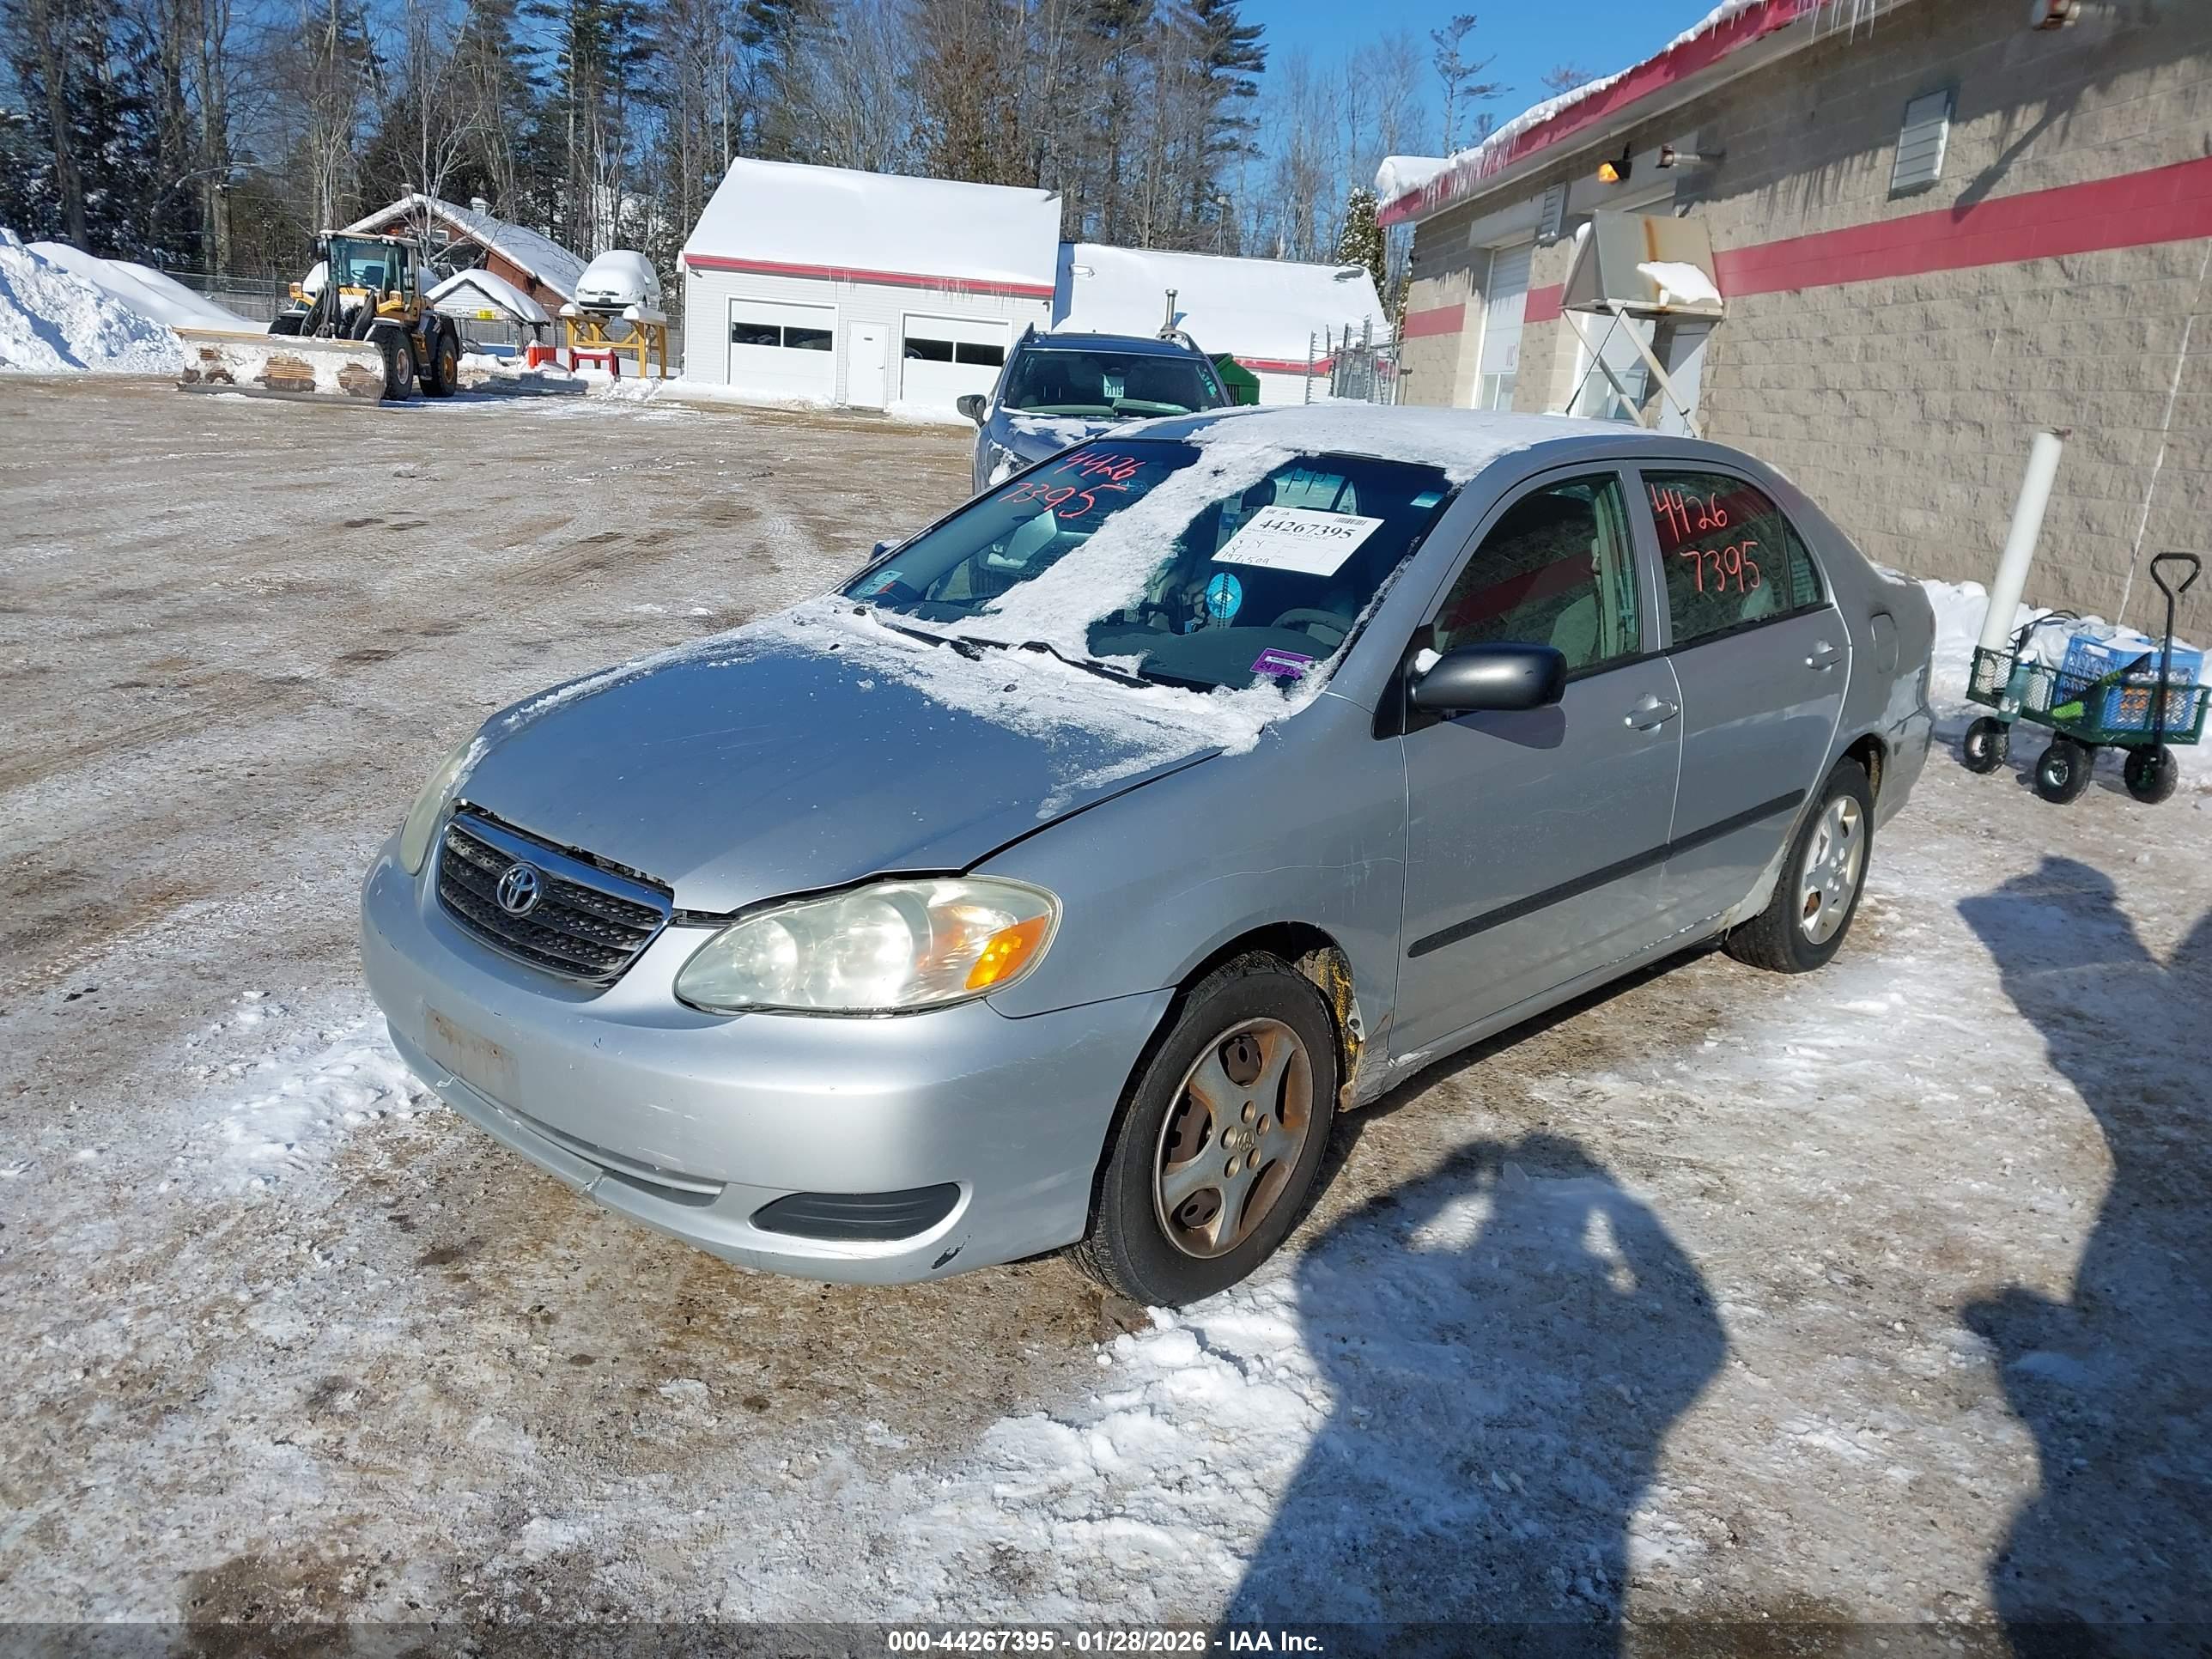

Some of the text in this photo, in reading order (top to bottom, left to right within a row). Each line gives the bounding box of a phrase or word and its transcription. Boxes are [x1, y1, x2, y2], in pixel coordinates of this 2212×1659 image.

[1054, 451, 1146, 481] 4426
[998, 483, 1127, 519] 7395
[1650, 483, 1728, 543] 4426
[1259, 519, 1358, 539] 44267395
[1680, 541, 1760, 592] 7395
